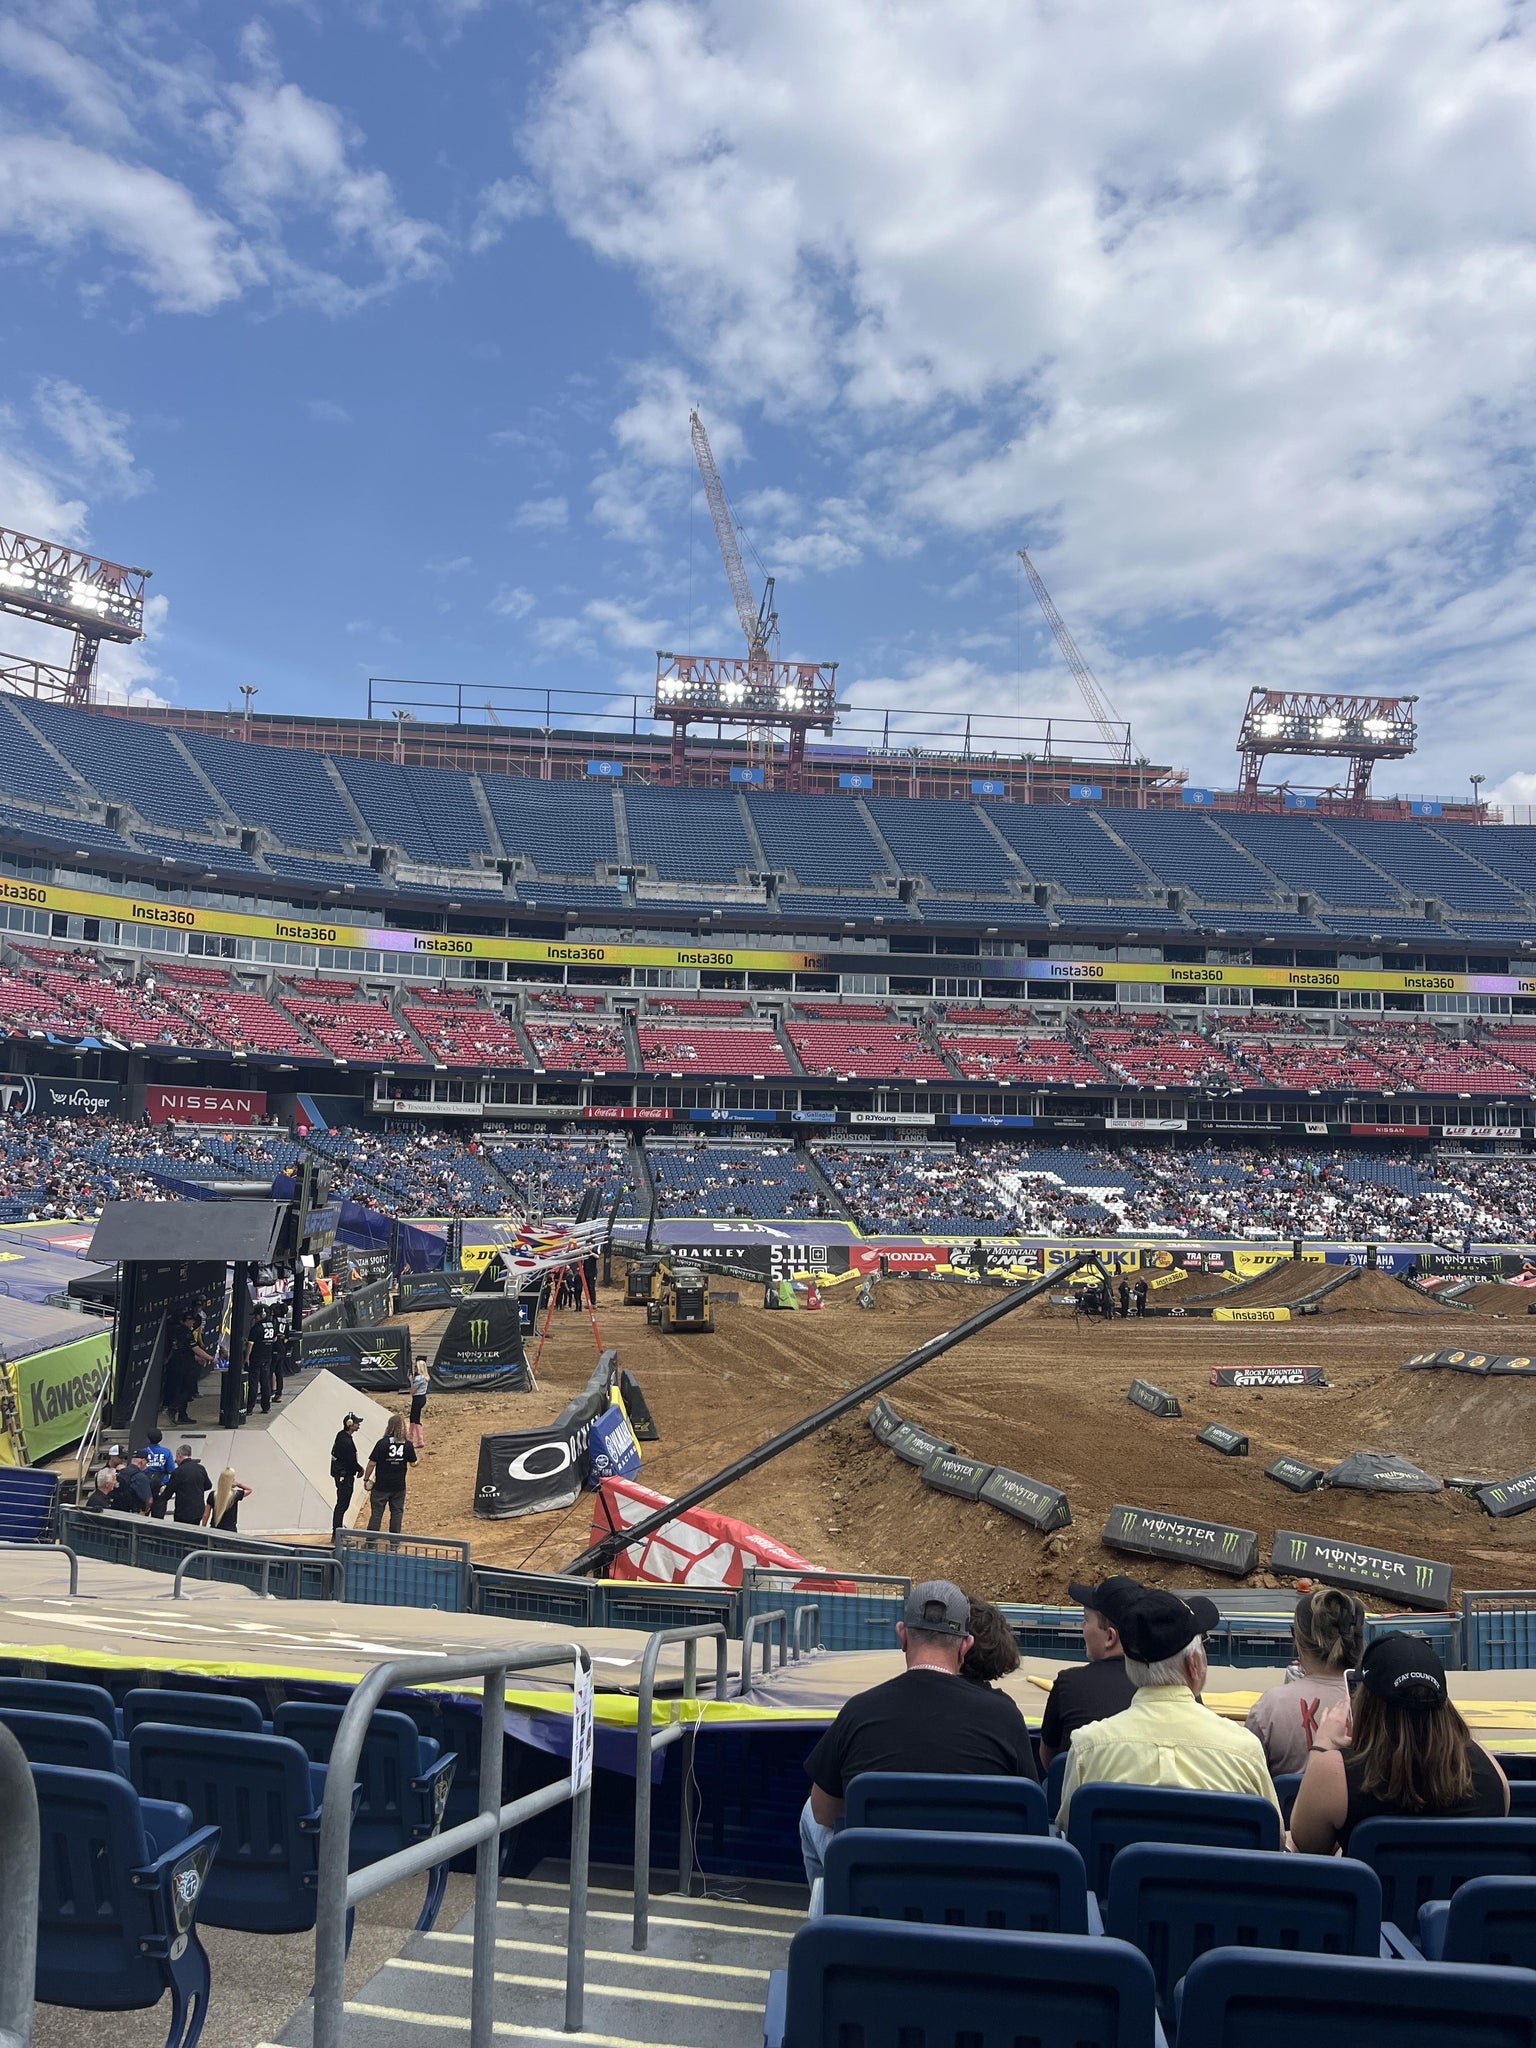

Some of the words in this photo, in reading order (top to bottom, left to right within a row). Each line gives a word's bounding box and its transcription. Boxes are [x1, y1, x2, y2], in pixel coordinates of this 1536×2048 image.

[132, 904, 195, 925] Insta360
[276, 922, 336, 942] Insta360
[414, 937, 472, 953] Insta360
[547, 946, 604, 960] Insta360
[677, 951, 733, 965] Insta360
[1050, 964, 1104, 977] Insta360
[1171, 968, 1223, 981] Insta360
[1289, 972, 1340, 985] Insta360
[1404, 976, 1454, 989] Insta360
[69, 1088, 110, 1115] Kroger
[161, 1094, 251, 1112] NISSAN
[864, 1115, 897, 1123] RJYoung
[672, 1123, 694, 1131] MIKE
[733, 1124, 747, 1132] JIM
[831, 1126, 848, 1134] KEN
[681, 1249, 745, 1257] OAKLEY
[771, 1245, 808, 1264] 5.11
[992, 1247, 1038, 1256] MOUNTAIN
[1048, 1250, 1137, 1265] SUUKI
[1186, 1252, 1222, 1260] TRAKER
[1357, 1255, 1394, 1266] YAAHA
[1436, 1254, 1488, 1265] MONSTER
[1156, 1272, 1184, 1287] Insta360
[1232, 1311, 1275, 1321] Insta360
[263, 1328, 275, 1339] 28
[360, 1352, 398, 1367] SMX
[457, 1350, 500, 1359] MONSTER
[1267, 1368, 1303, 1376] MOUNTAIN
[388, 1445, 404, 1457] 34
[942, 1460, 974, 1477] MONSTER
[1002, 1480, 1039, 1504] MONSTER
[1142, 1518, 1215, 1542] MONSTER
[1150, 1532, 1201, 1547] ENERGY
[1315, 1546, 1406, 1576] MONSTER
[1328, 1562, 1391, 1580] ENERGY
[1393, 1672, 1410, 1688] STAY
[1410, 1672, 1441, 1689] COUNTRY
